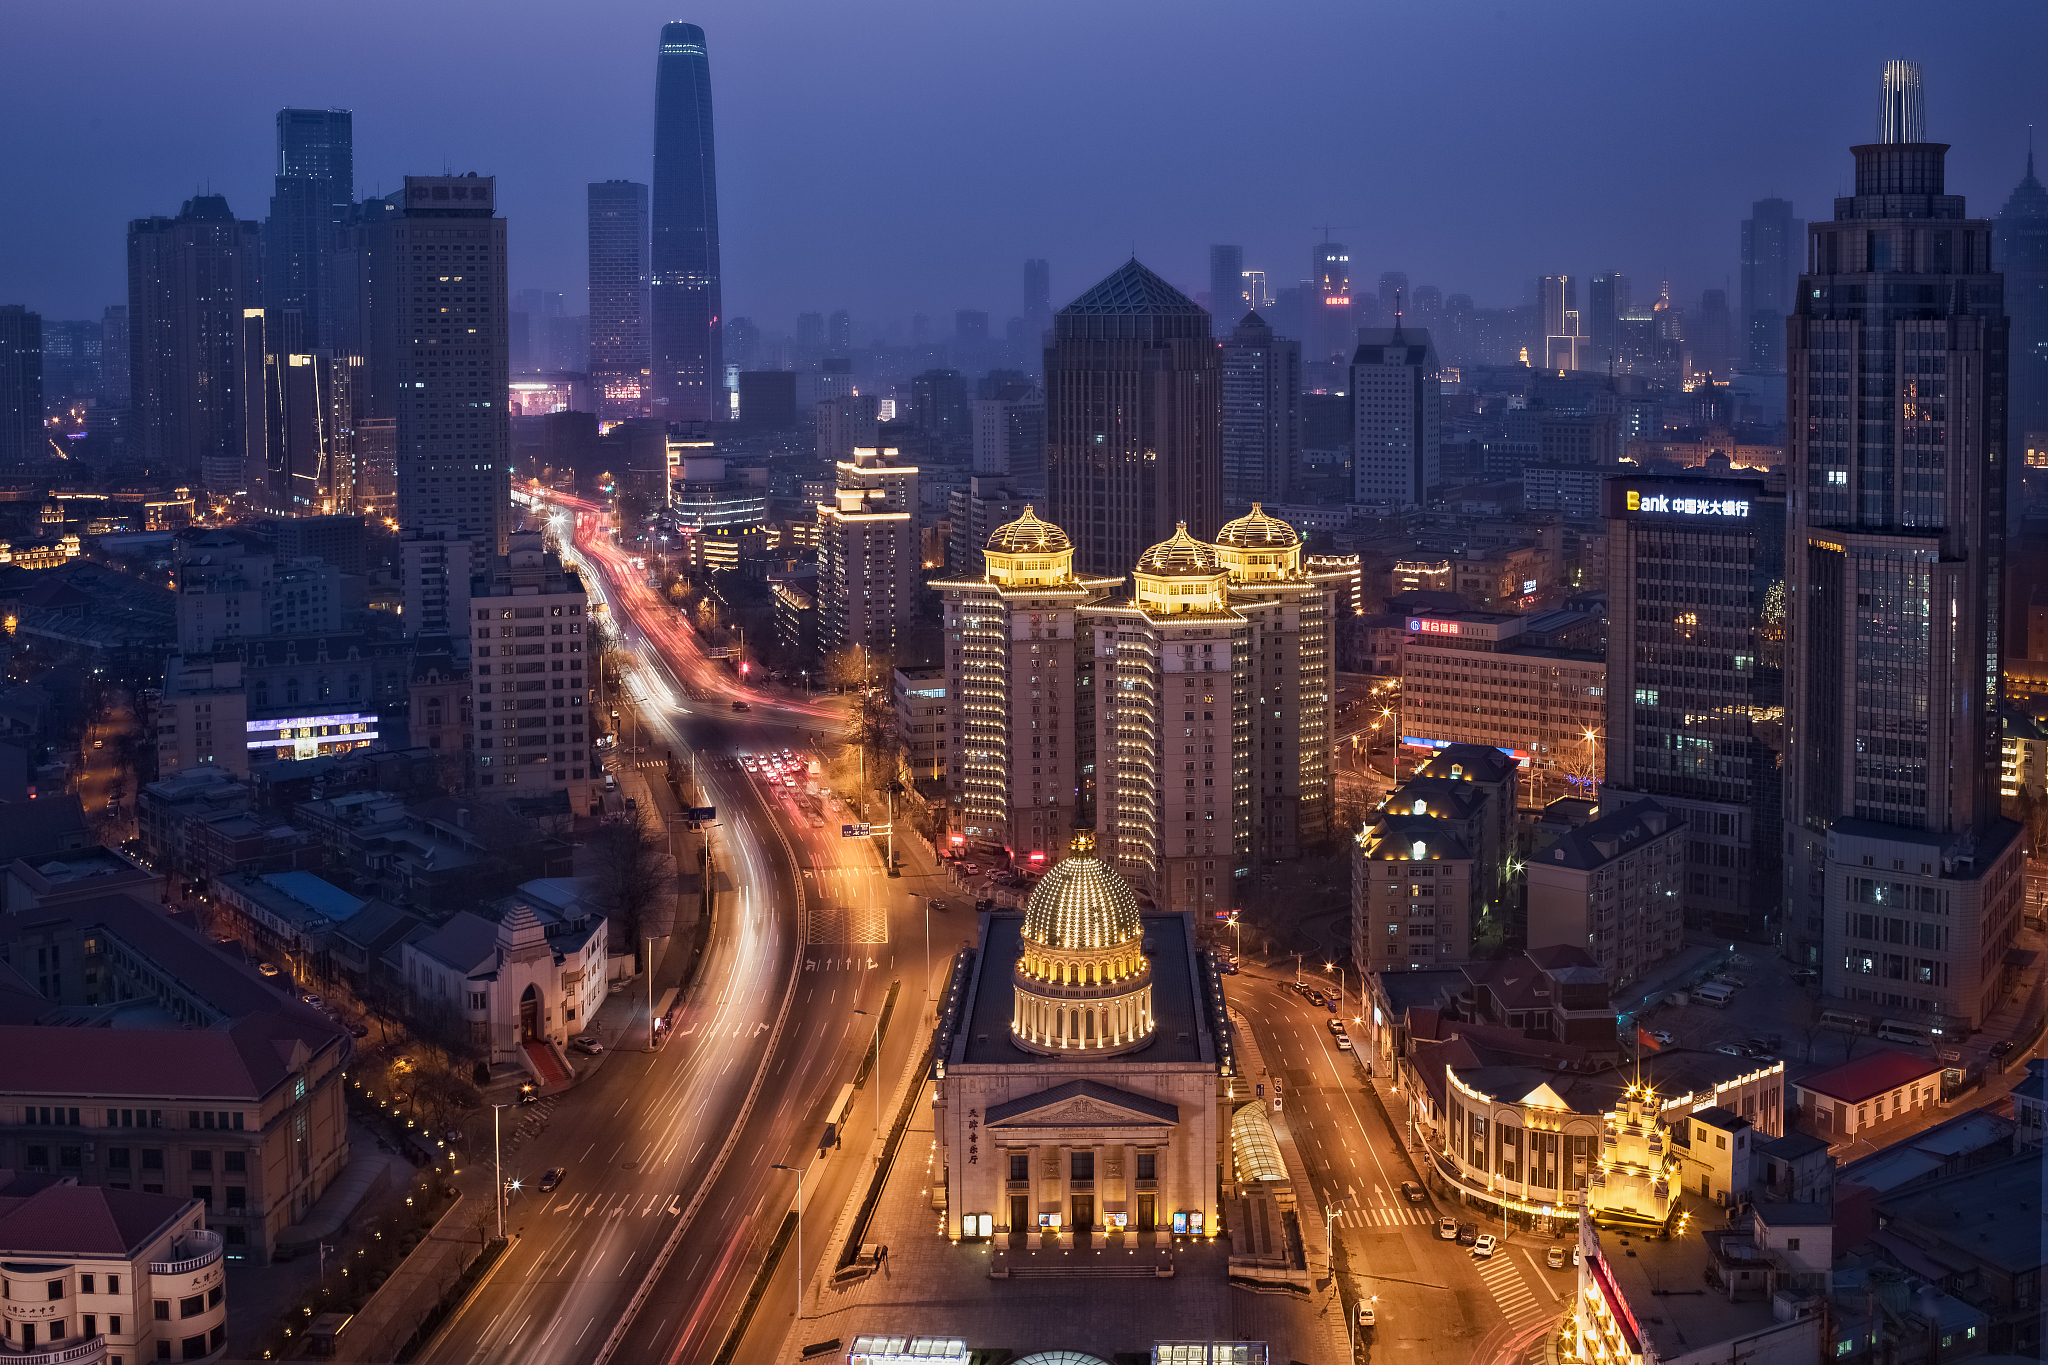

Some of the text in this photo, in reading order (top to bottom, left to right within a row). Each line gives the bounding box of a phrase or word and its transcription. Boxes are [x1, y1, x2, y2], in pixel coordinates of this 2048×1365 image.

[1626, 490, 1749, 517] Bank 中国光大银行
[1421, 621, 1458, 634] 联合信用
[968, 1108, 979, 1165] 天津音乐厅
[1499, 1198, 1521, 1211] Goria
